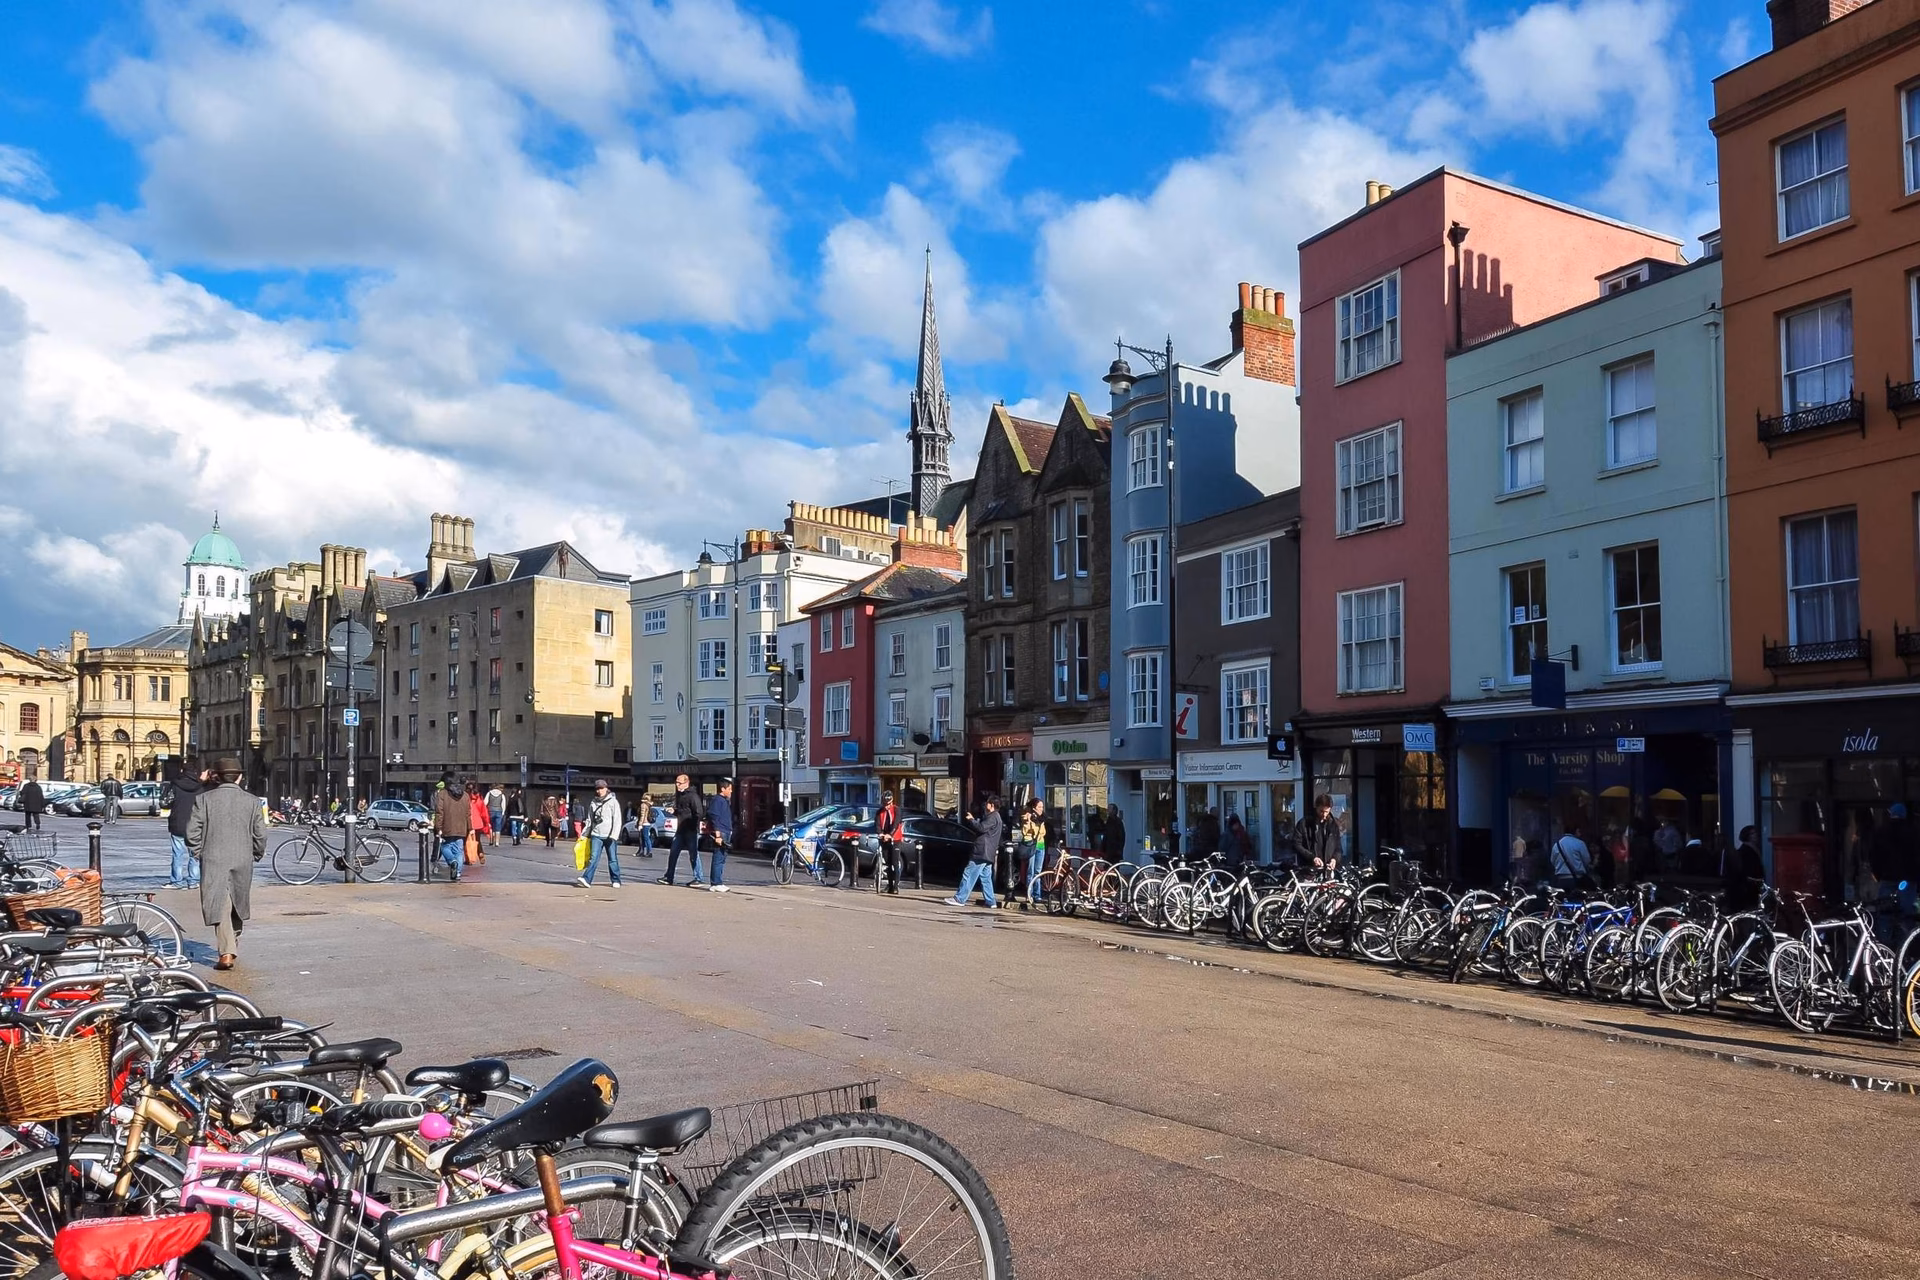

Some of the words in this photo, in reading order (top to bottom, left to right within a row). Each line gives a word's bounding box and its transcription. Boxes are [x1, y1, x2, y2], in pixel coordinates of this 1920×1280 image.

[1351, 729, 1381, 739] Western
[1405, 731, 1434, 744] OMC
[1843, 727, 1879, 752] isola
[1062, 740, 1088, 753] Oxfam
[1525, 753, 1545, 765] The
[1552, 752, 1589, 767] Varsity
[1596, 751, 1625, 765] Shop
[1199, 763, 1225, 771] Information
[1225, 762, 1242, 771] Centre
